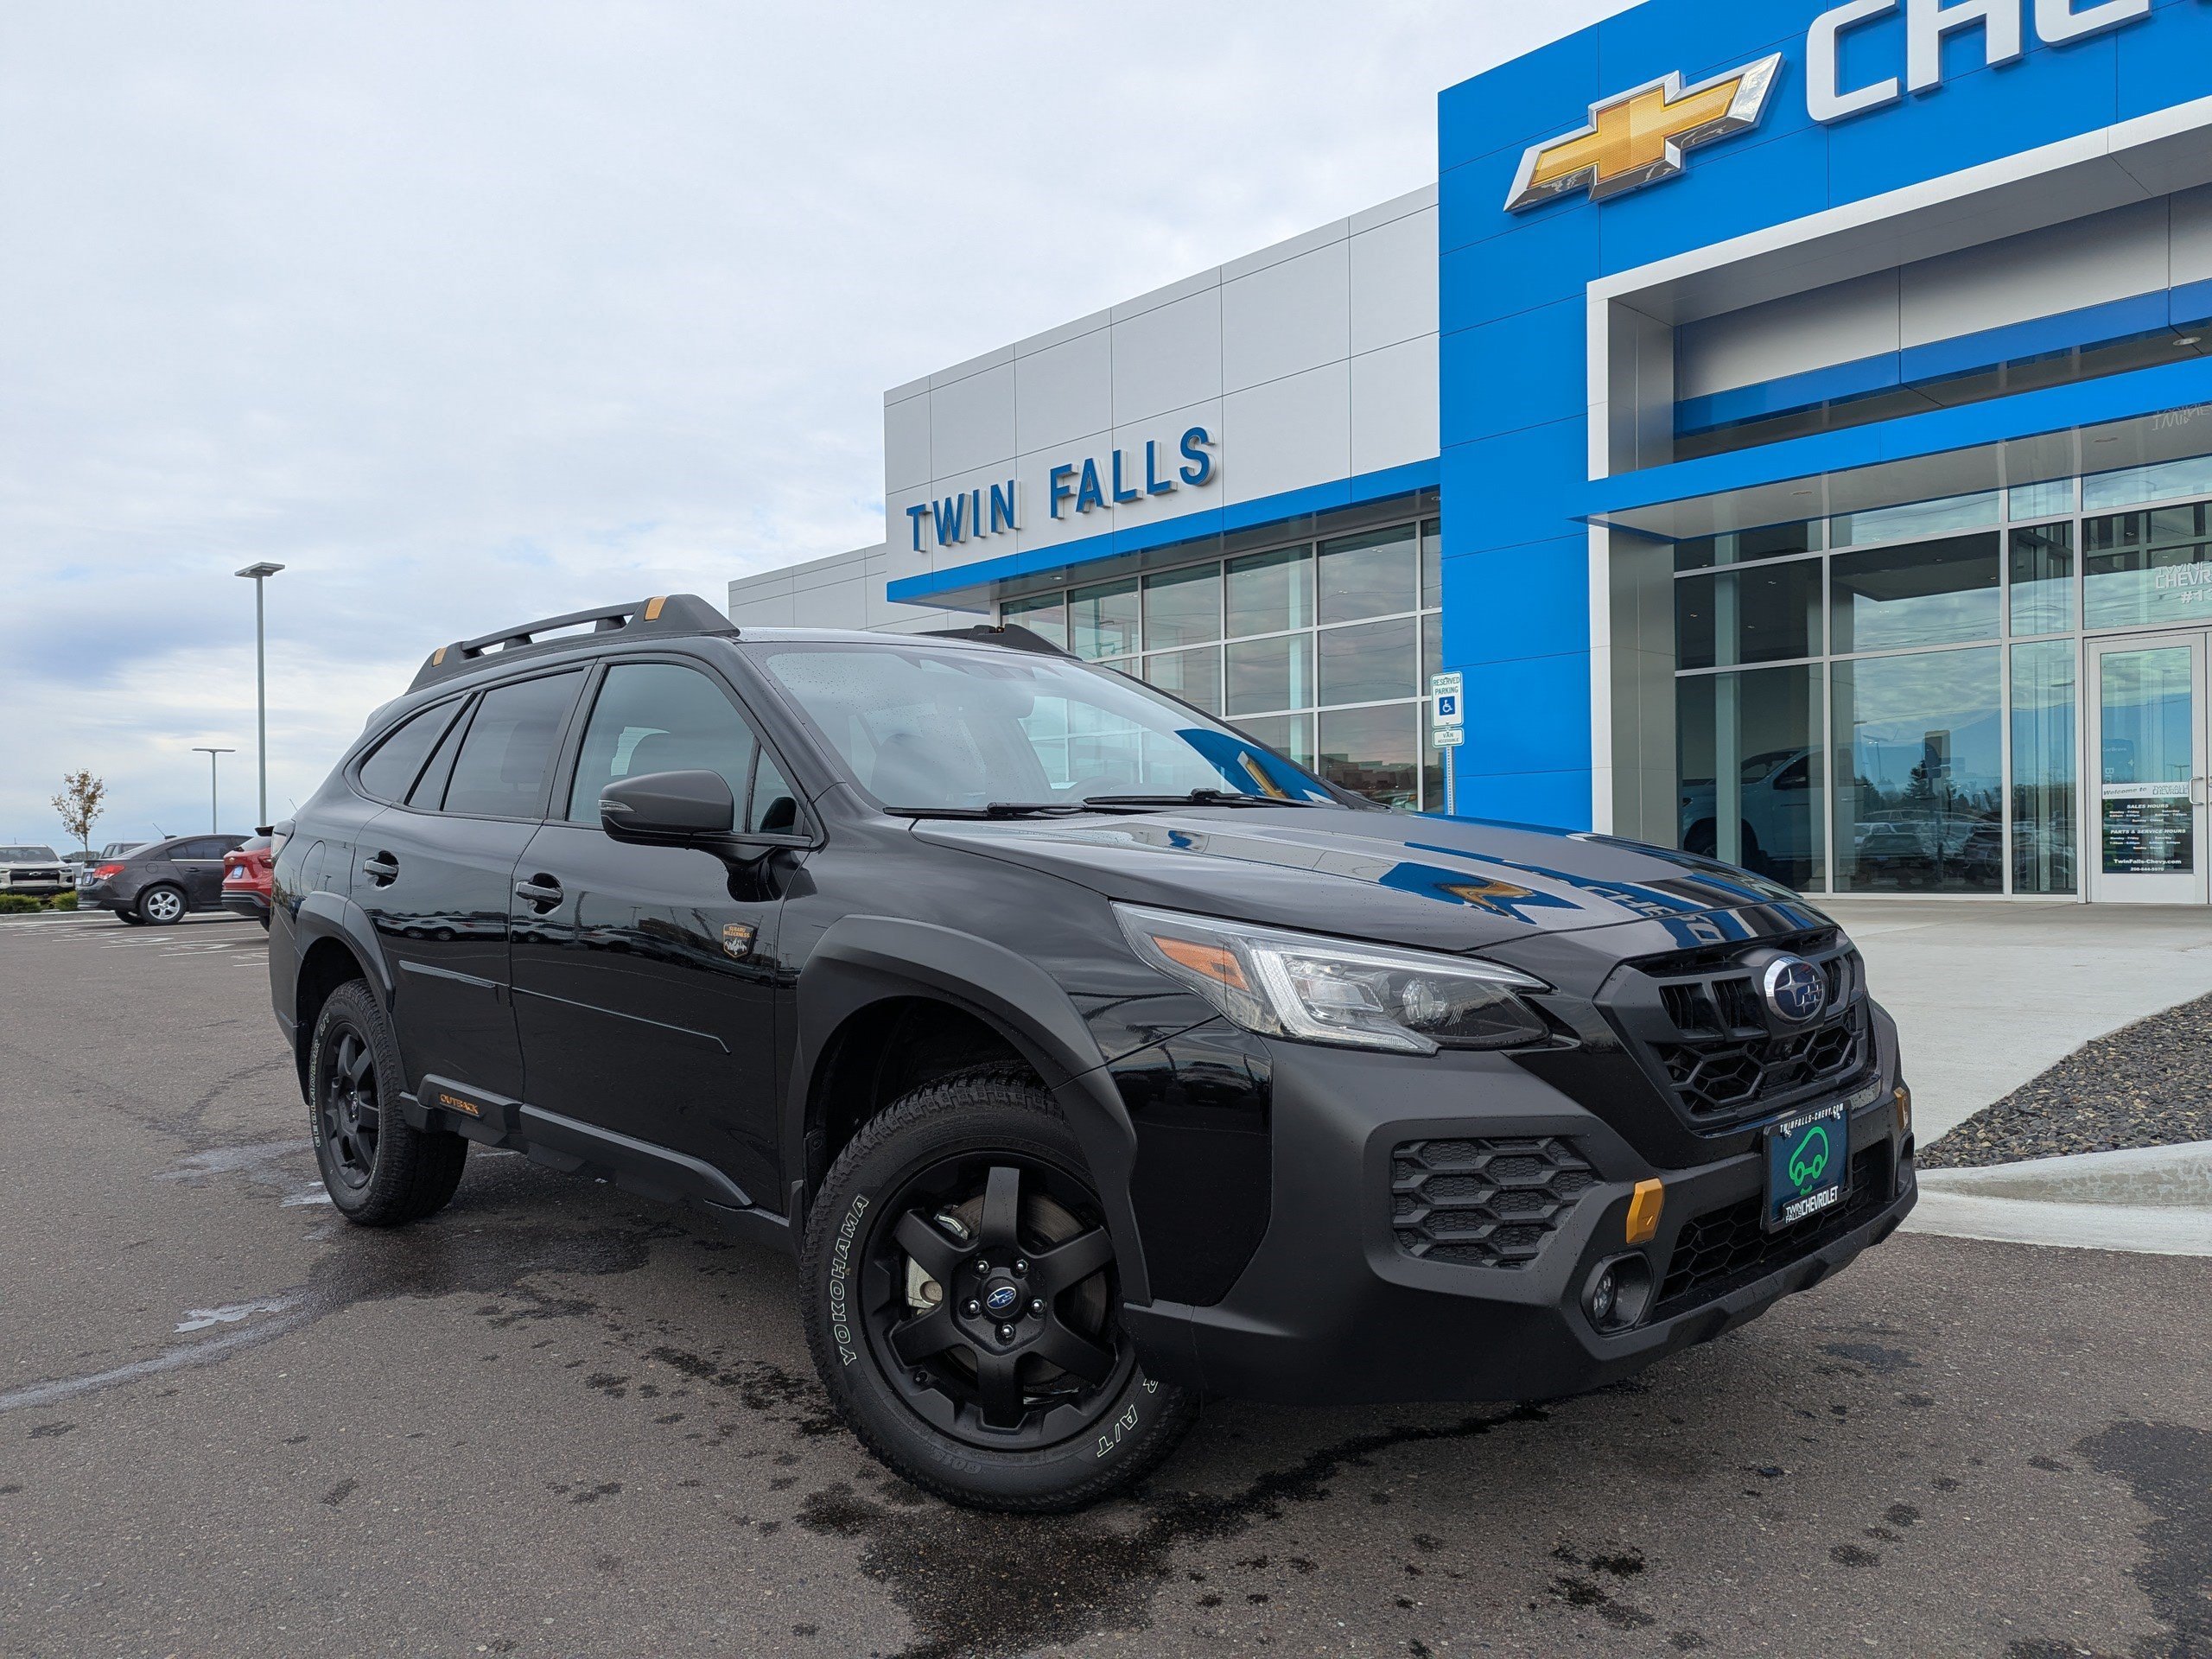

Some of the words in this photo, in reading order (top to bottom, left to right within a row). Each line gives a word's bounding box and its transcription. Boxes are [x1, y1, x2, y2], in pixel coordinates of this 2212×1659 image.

[906, 480, 1020, 553] TWIN
[1050, 427, 1216, 520] FALLS
[1433, 677, 1460, 687] RESERVED
[1434, 686, 1459, 696] PARKING
[2103, 787, 2138, 796] Welcome
[439, 1093, 479, 1115] OUTBACK
[1785, 1202, 1802, 1216] TWIN
[1801, 1185, 1839, 1217] CHEVROLET
[1785, 1211, 1802, 1224] FALLS
[830, 1193, 869, 1366] YOKOHAMA
[1096, 1404, 1138, 1458] A/T
